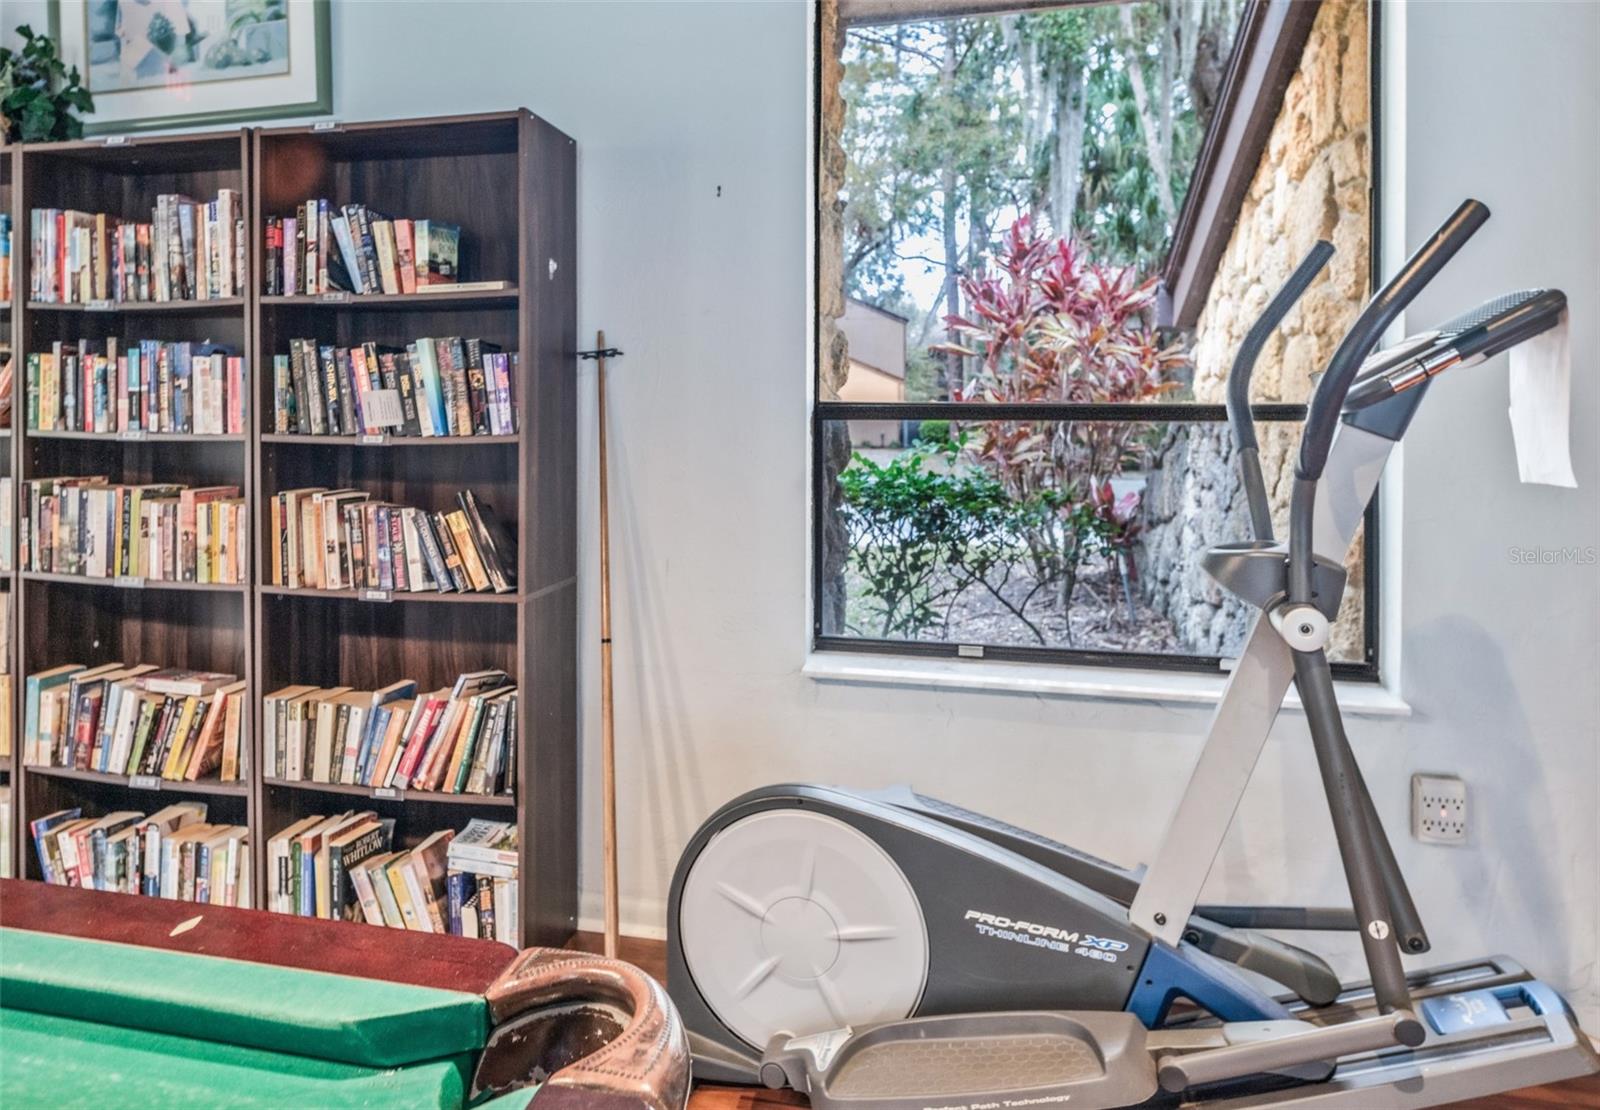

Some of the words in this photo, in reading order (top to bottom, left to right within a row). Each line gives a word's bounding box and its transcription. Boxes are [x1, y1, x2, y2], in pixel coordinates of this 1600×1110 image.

[343, 836, 383, 867] WHITLOW
[964, 910, 1080, 943] PRO-FORM
[1078, 934, 1129, 952] XP
[975, 924, 1070, 953] THINLINE
[970, 1101, 1000, 1110] Path
[1002, 1095, 1071, 1107] Technology
